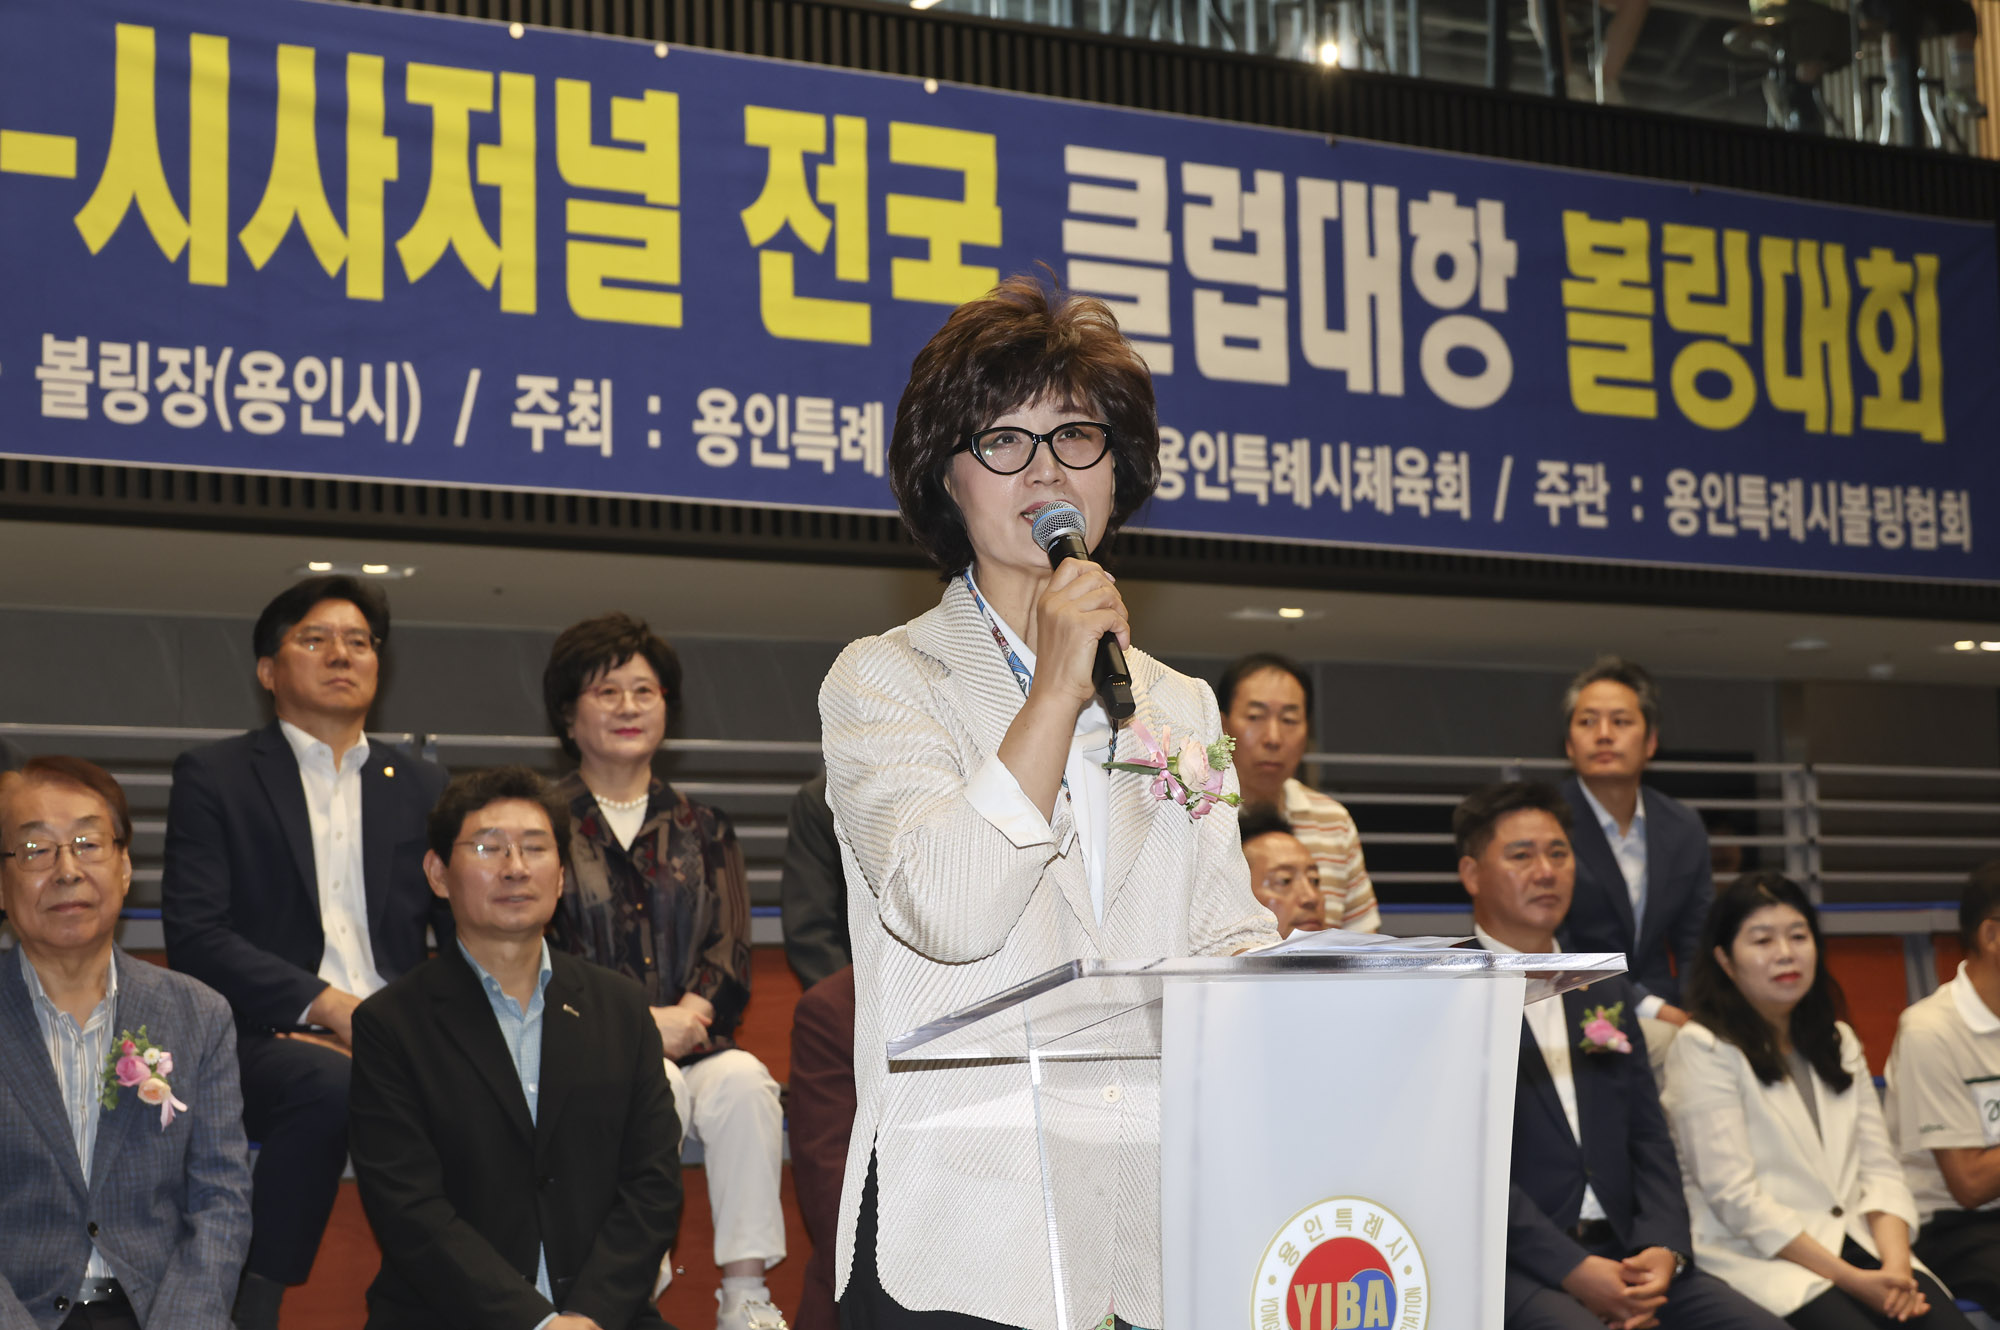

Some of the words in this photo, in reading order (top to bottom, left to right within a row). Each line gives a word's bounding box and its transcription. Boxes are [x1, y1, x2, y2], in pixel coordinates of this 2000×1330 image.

[740, 104, 1002, 346] 전국
[1063, 144, 1518, 409] 클럽대항
[1562, 210, 1945, 443] 볼링대회
[35, 333, 421, 445] 볼링장(용인시)
[453, 368, 481, 447] /
[511, 374, 613, 458] 주최
[692, 388, 889, 478] 용인특례
[1154, 425, 1471, 521] 용인특례시체육회
[1494, 455, 1513, 522] /
[1534, 460, 1609, 528] 주관
[1664, 468, 1971, 552] 용인특례시볼링협회
[1278, 1207, 1408, 1267] 용인특례시
[1261, 1297, 1281, 1330] YONG
[1293, 1279, 1389, 1330] YIBA
[1400, 1286, 1422, 1330] IATION
